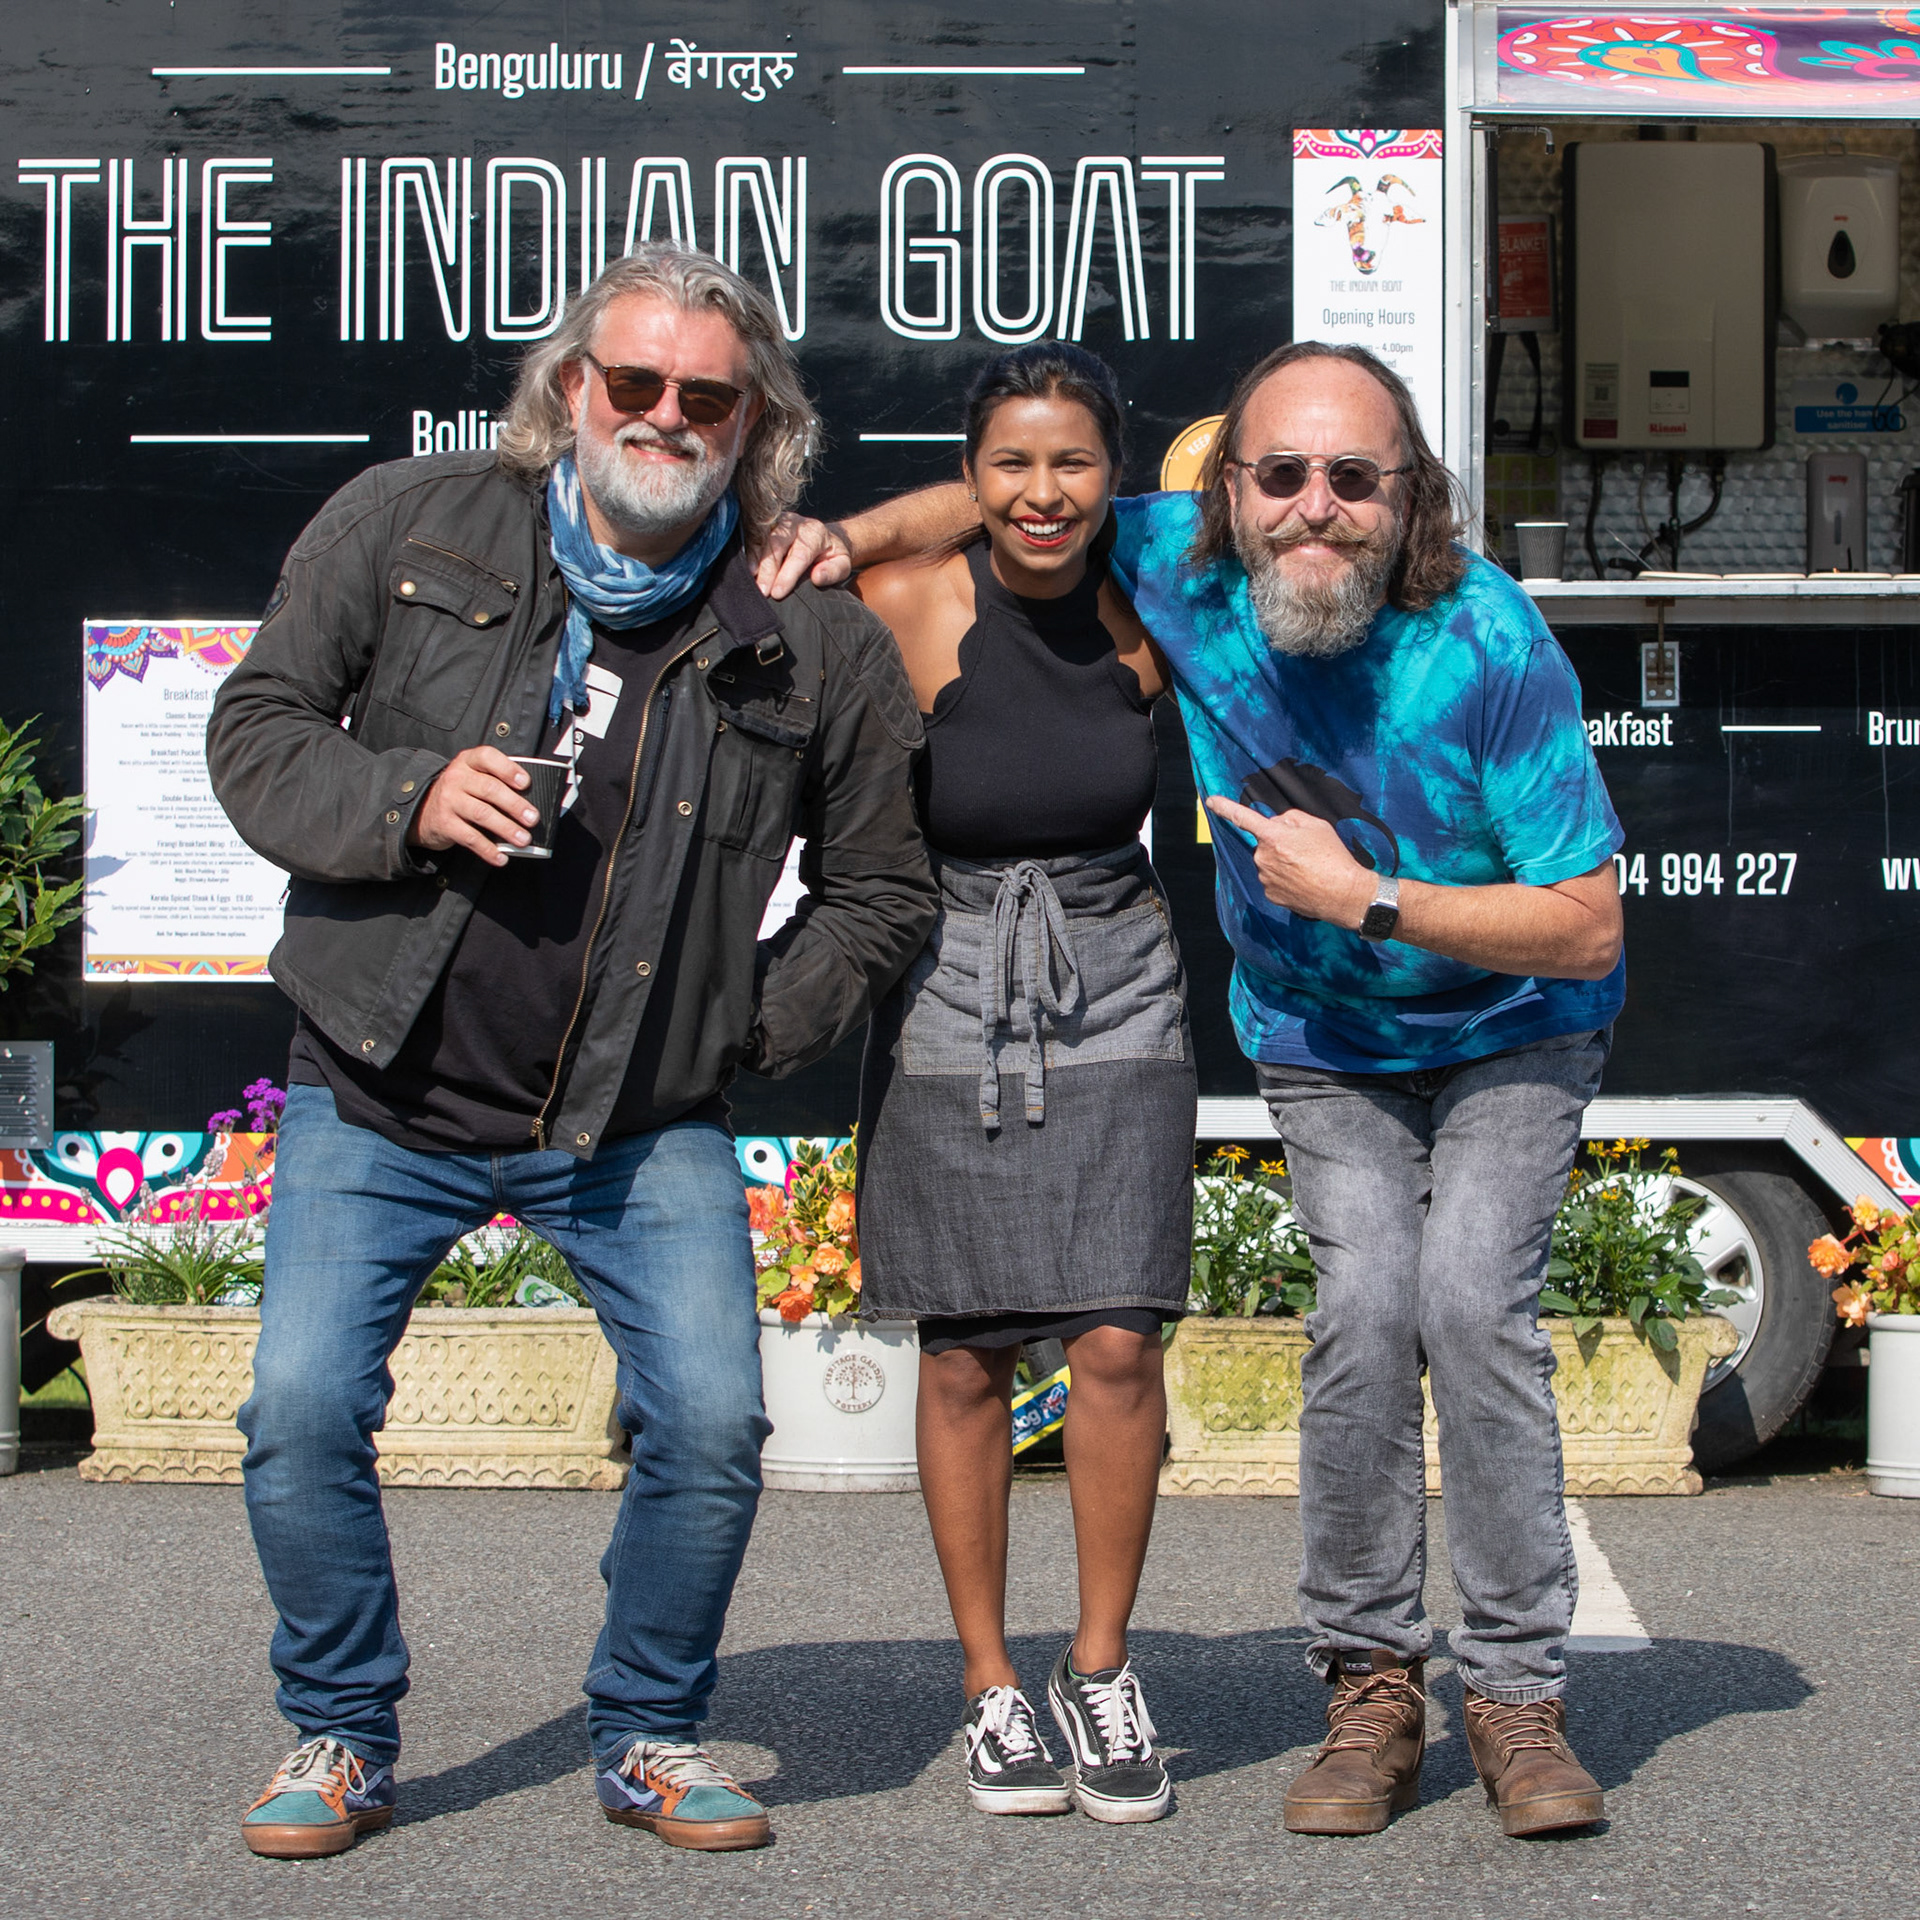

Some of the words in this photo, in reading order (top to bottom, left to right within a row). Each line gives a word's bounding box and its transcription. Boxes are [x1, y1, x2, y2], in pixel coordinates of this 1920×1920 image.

[435, 42, 622, 99] Benguluru
[665, 38, 798, 102] बेंगलुरु
[18, 157, 274, 342] THE
[880, 153, 1225, 344] GOAT
[1330, 280, 1346, 292] THE
[1322, 308, 1374, 328] Opening
[1378, 308, 1415, 325] Hours
[1381, 343, 1414, 354] 4.00pm
[1816, 409, 1834, 418] Use
[1837, 409, 1853, 418] the
[163, 688, 208, 701] Breakfast
[165, 712, 186, 720] Classic
[187, 712, 205, 720] Bacon
[1583, 711, 1673, 746] akfast
[151, 749, 179, 757] Breakfast
[179, 840, 206, 848] Breakfast
[209, 840, 225, 849] Wrap
[1662, 853, 1724, 896] 994
[1737, 853, 1797, 896] 227
[150, 894, 169, 902] Kerala
[170, 894, 191, 903] Spiced
[192, 894, 209, 902] Steak
[216, 894, 230, 903] Eggs
[824, 1354, 857, 1386] HERITAGE
[860, 1355, 884, 1388] GARDEN
[835, 1399, 873, 1411] POTTERY
